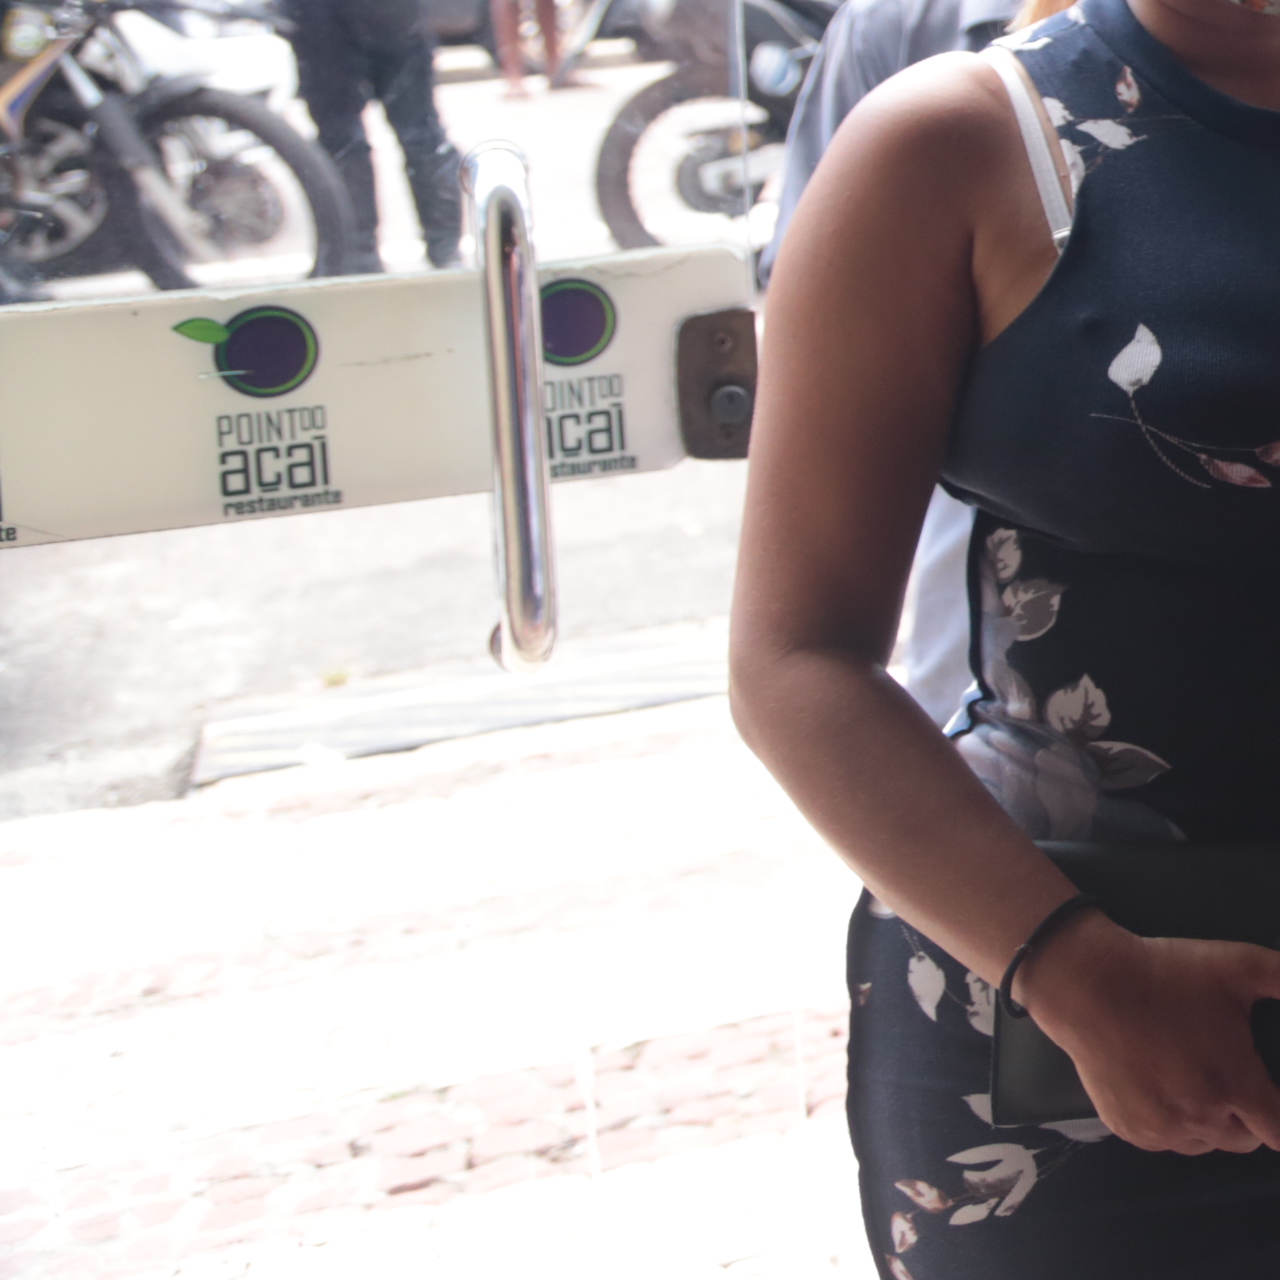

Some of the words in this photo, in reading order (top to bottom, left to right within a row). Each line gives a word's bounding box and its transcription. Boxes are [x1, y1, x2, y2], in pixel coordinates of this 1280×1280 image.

[544, 376, 595, 413] OINT
[545, 401, 626, 460] çaí
[550, 455, 637, 479] staurante
[223, 489, 343, 517] restaurante
